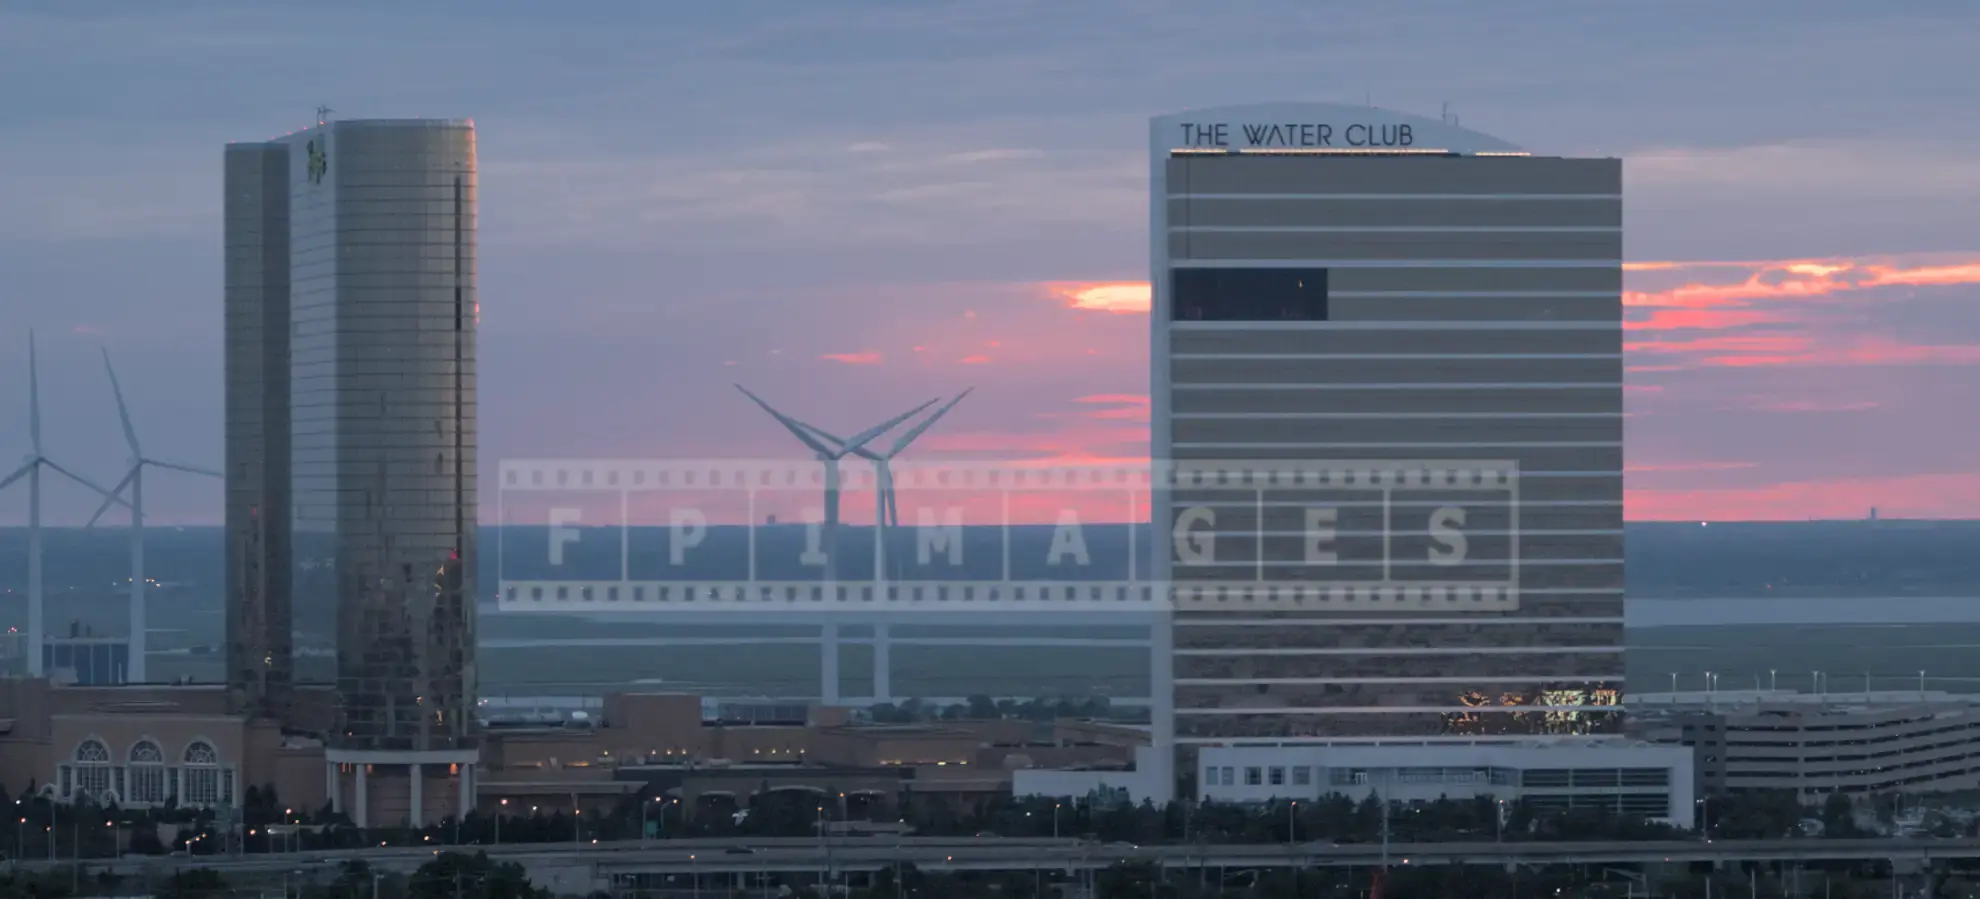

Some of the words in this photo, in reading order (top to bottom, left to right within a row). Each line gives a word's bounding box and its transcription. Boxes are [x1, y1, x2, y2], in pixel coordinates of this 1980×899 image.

[1180, 123, 1229, 146] THE
[1242, 123, 1333, 146] WATER
[1345, 123, 1414, 146] CLUB
